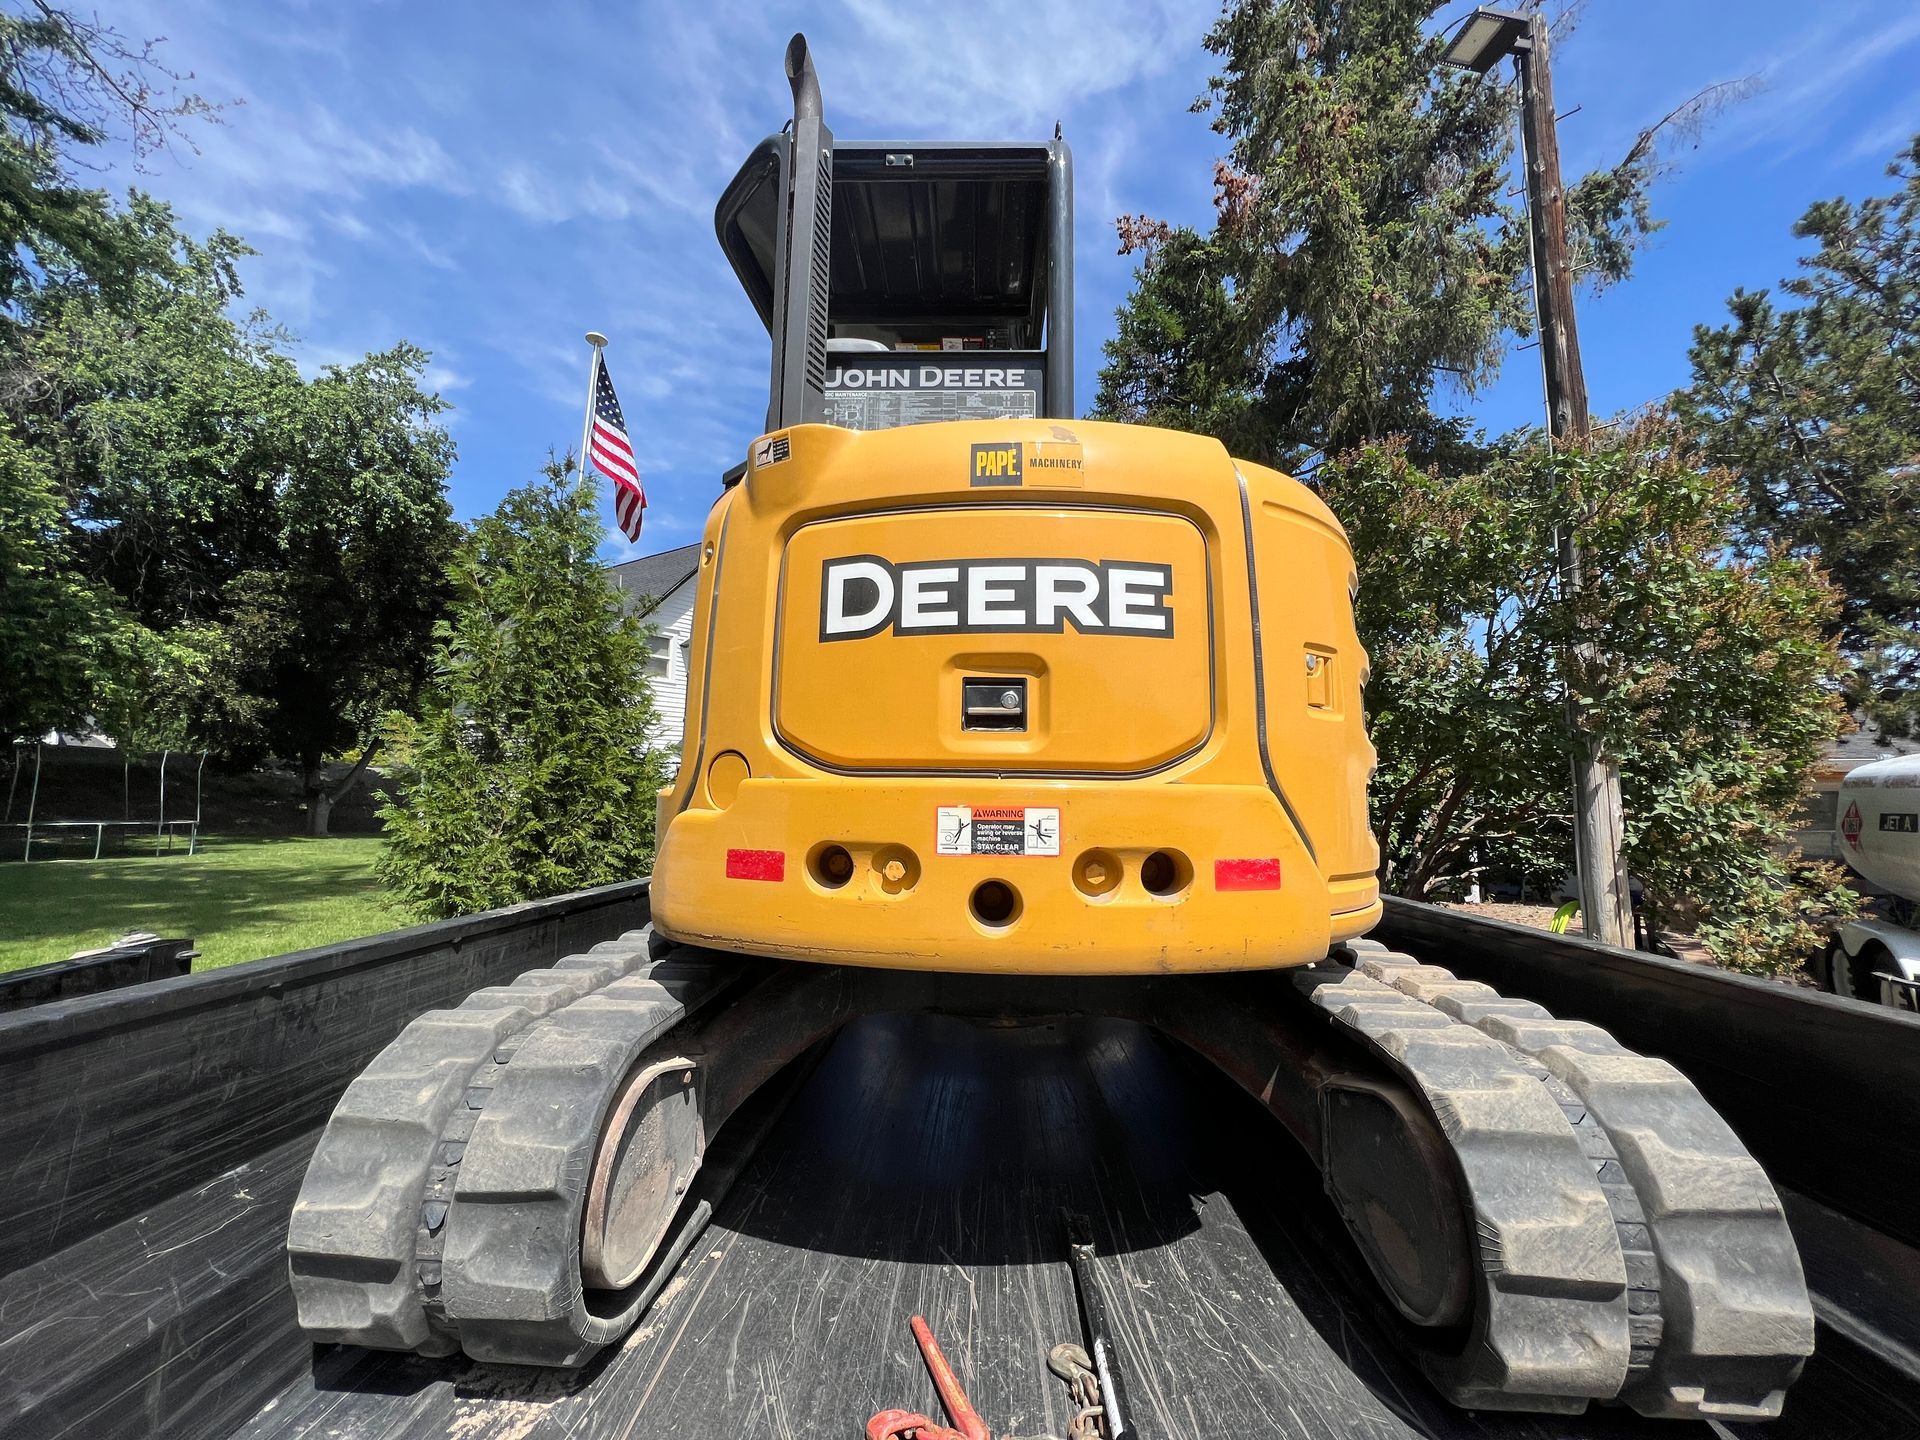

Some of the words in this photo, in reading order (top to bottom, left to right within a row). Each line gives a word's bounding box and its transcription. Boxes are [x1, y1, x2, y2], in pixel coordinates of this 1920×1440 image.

[825, 366, 910, 388] JOHN
[919, 366, 1025, 387] DEERE
[1029, 458, 1082, 469] MACHINERY
[826, 562, 1166, 634] DEERE
[981, 810, 1024, 818] WARNING
[1884, 815, 1901, 830] JET
[1904, 815, 1912, 831] A
